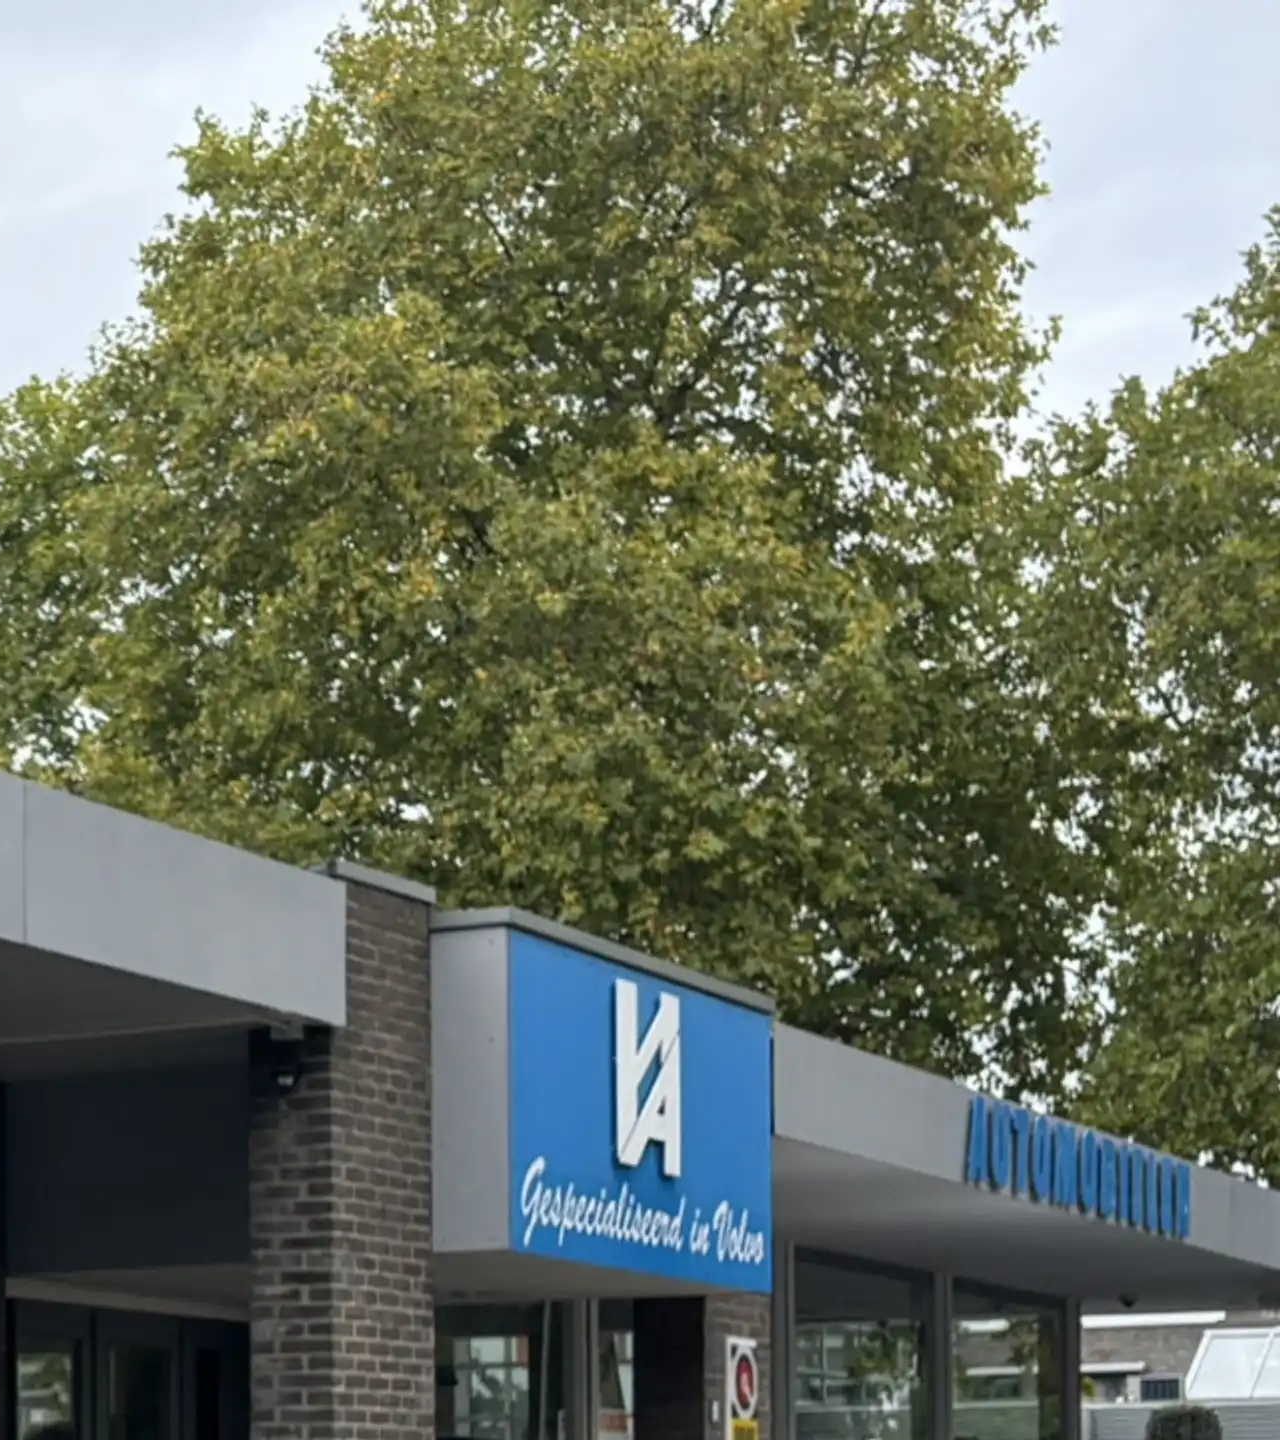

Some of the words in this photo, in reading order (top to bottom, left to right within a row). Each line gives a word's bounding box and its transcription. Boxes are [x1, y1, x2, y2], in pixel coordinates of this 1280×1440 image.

[521, 1155, 686, 1252] Gespecialiseerd
[690, 1208, 711, 1257] in
[712, 1199, 765, 1265] Volvo
